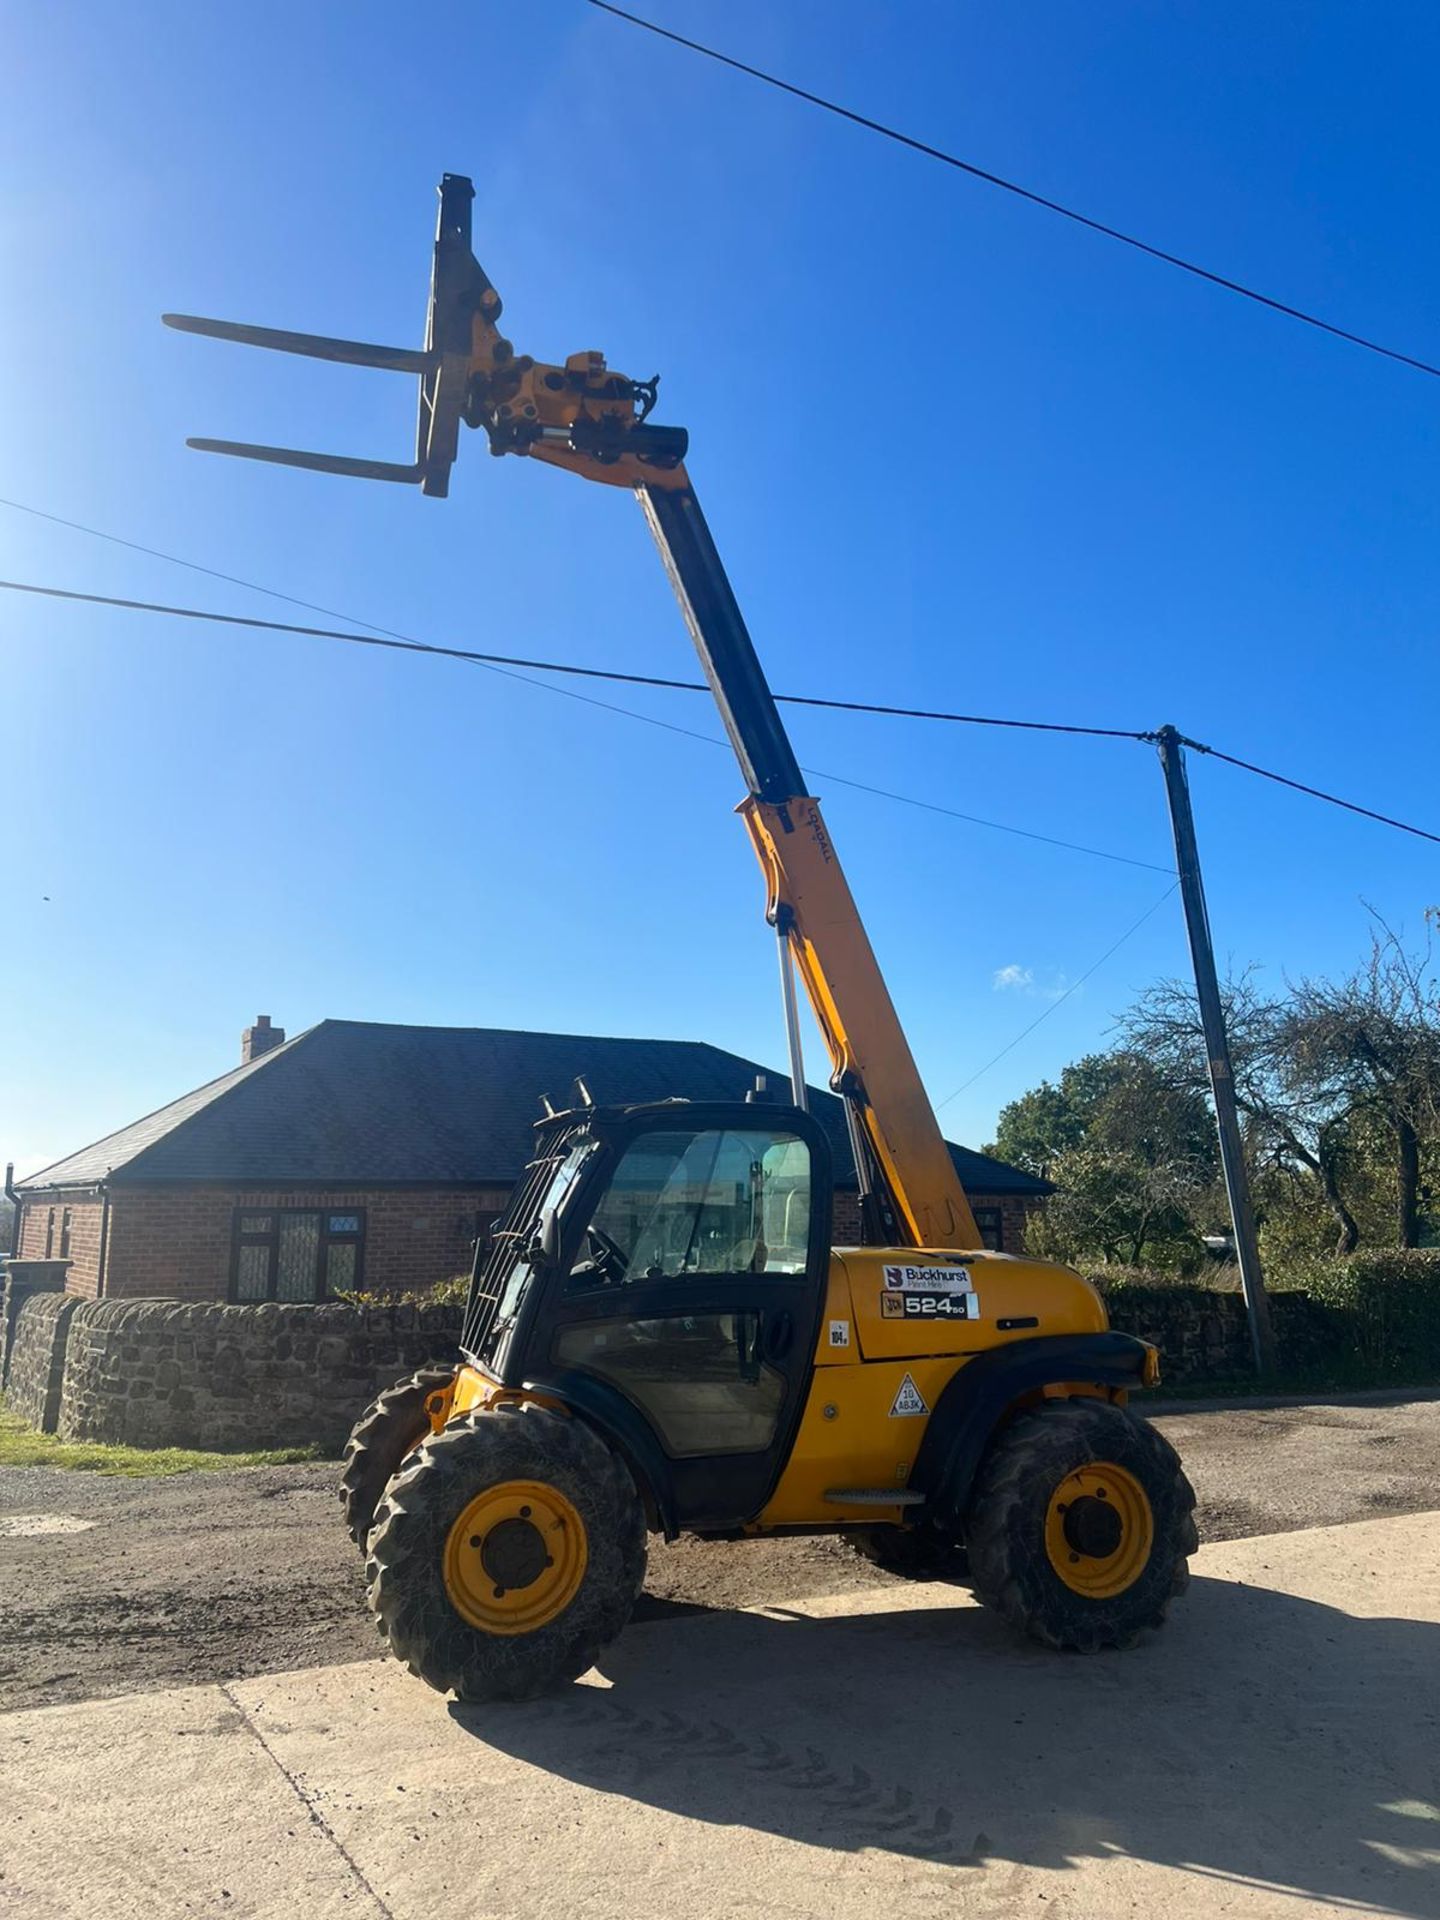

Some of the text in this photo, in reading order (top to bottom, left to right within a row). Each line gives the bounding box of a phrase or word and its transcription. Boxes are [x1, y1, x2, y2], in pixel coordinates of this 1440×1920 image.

[807, 807, 832, 864] LOADALL
[905, 1268, 968, 1281] Buckhurst
[905, 1297, 952, 1313] 524
